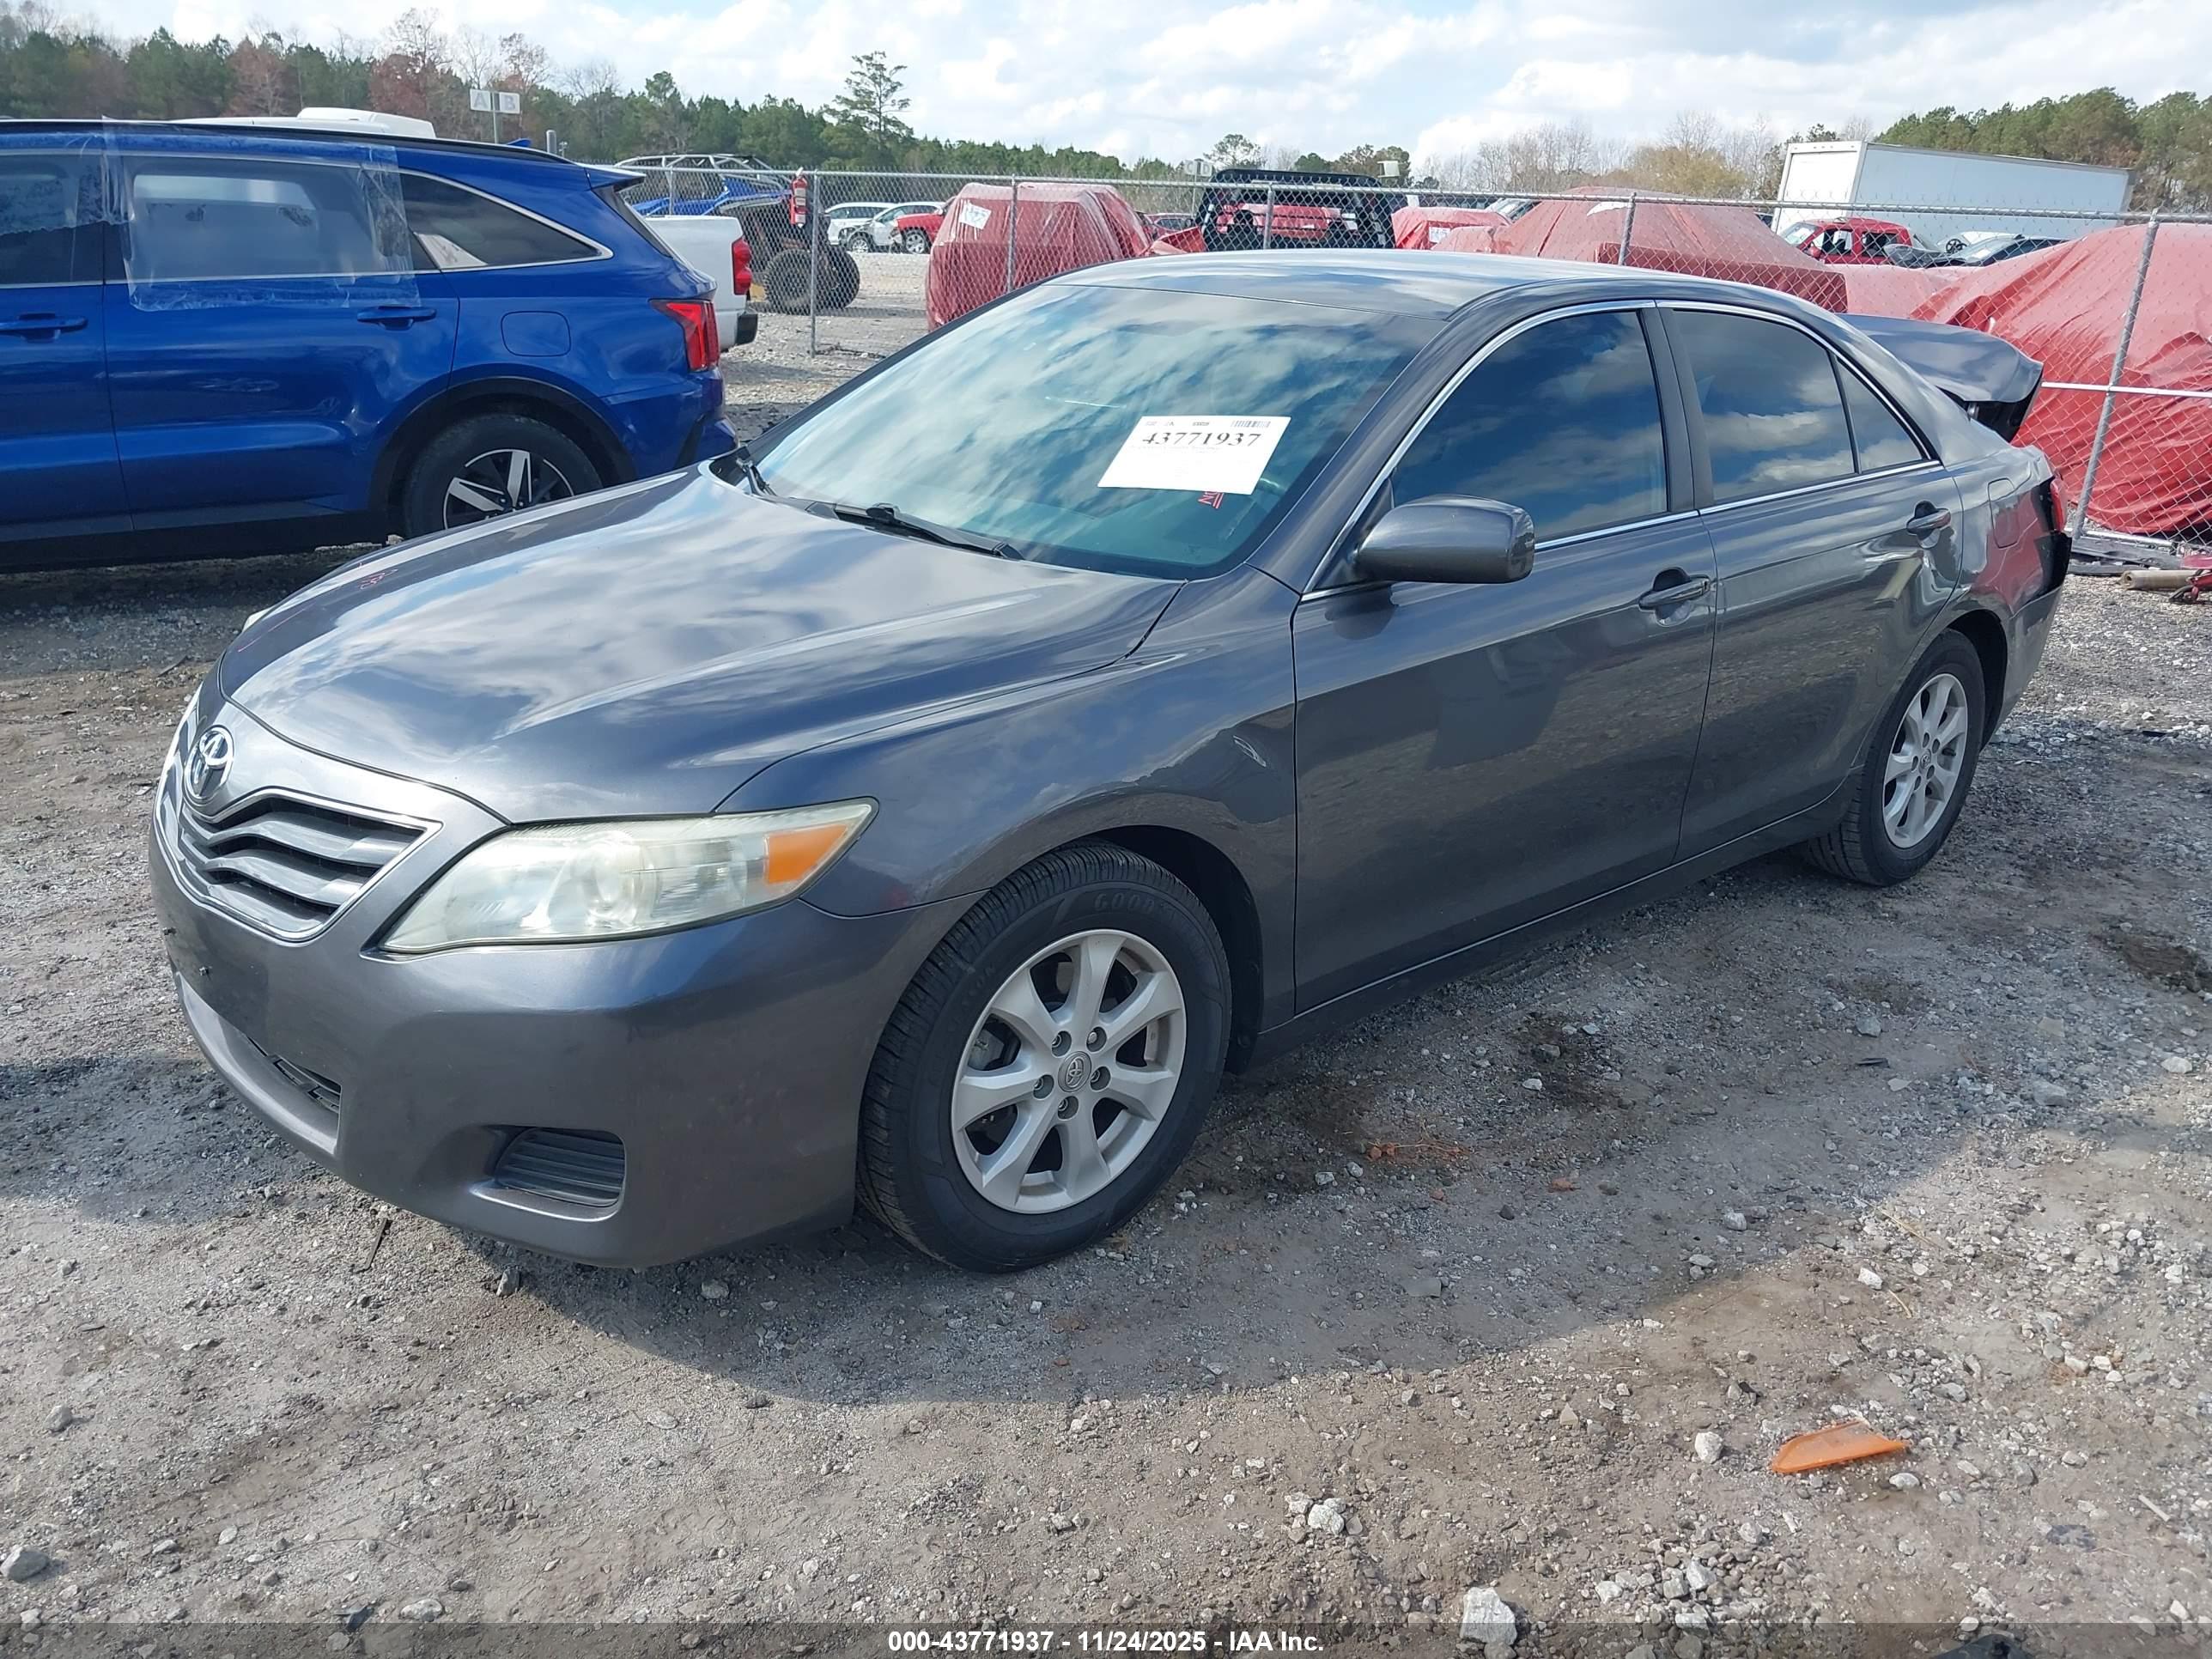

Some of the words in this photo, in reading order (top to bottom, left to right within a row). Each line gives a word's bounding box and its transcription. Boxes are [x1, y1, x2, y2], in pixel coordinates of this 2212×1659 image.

[473, 92, 489, 109] A
[504, 94, 516, 111] B
[1142, 432, 1261, 447] 43771937
